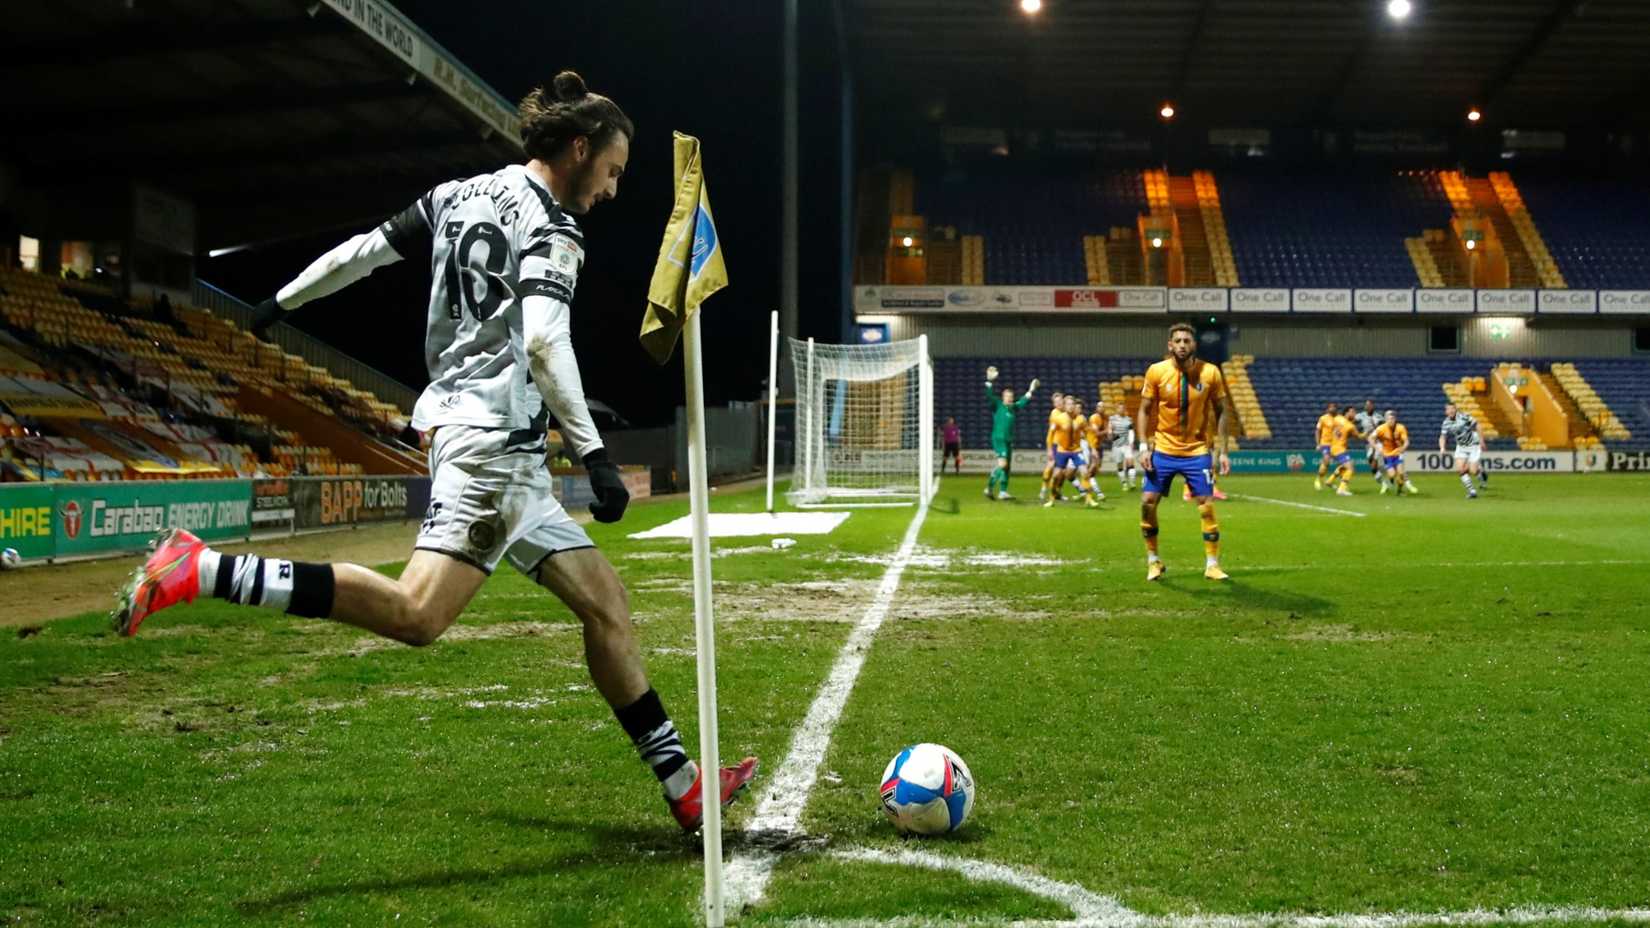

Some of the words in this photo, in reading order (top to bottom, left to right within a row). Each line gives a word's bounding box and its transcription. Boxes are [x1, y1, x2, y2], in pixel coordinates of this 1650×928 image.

[367, 3, 383, 37] THE
[385, 21, 413, 58] WORLD
[1174, 291, 1197, 302] One
[1201, 291, 1222, 302] Call
[1235, 291, 1260, 302] One
[1263, 291, 1284, 302] Call
[1297, 292, 1322, 302] One
[1325, 292, 1346, 302] Call
[1360, 292, 1383, 303] One
[1386, 292, 1407, 303] Call
[1421, 292, 1445, 303] One
[1447, 292, 1469, 303] Call
[1482, 293, 1506, 304] One
[1508, 293, 1530, 304] Call
[1543, 294, 1567, 304] One
[1569, 294, 1591, 304] Call
[1603, 294, 1627, 304] One
[321, 481, 363, 524] BAPP
[364, 480, 380, 509] for
[380, 480, 408, 508] Bolts
[0, 506, 51, 539] HIRE
[90, 498, 164, 538] Carabao
[168, 501, 215, 530] ENERGY
[216, 499, 250, 529] DRINK
